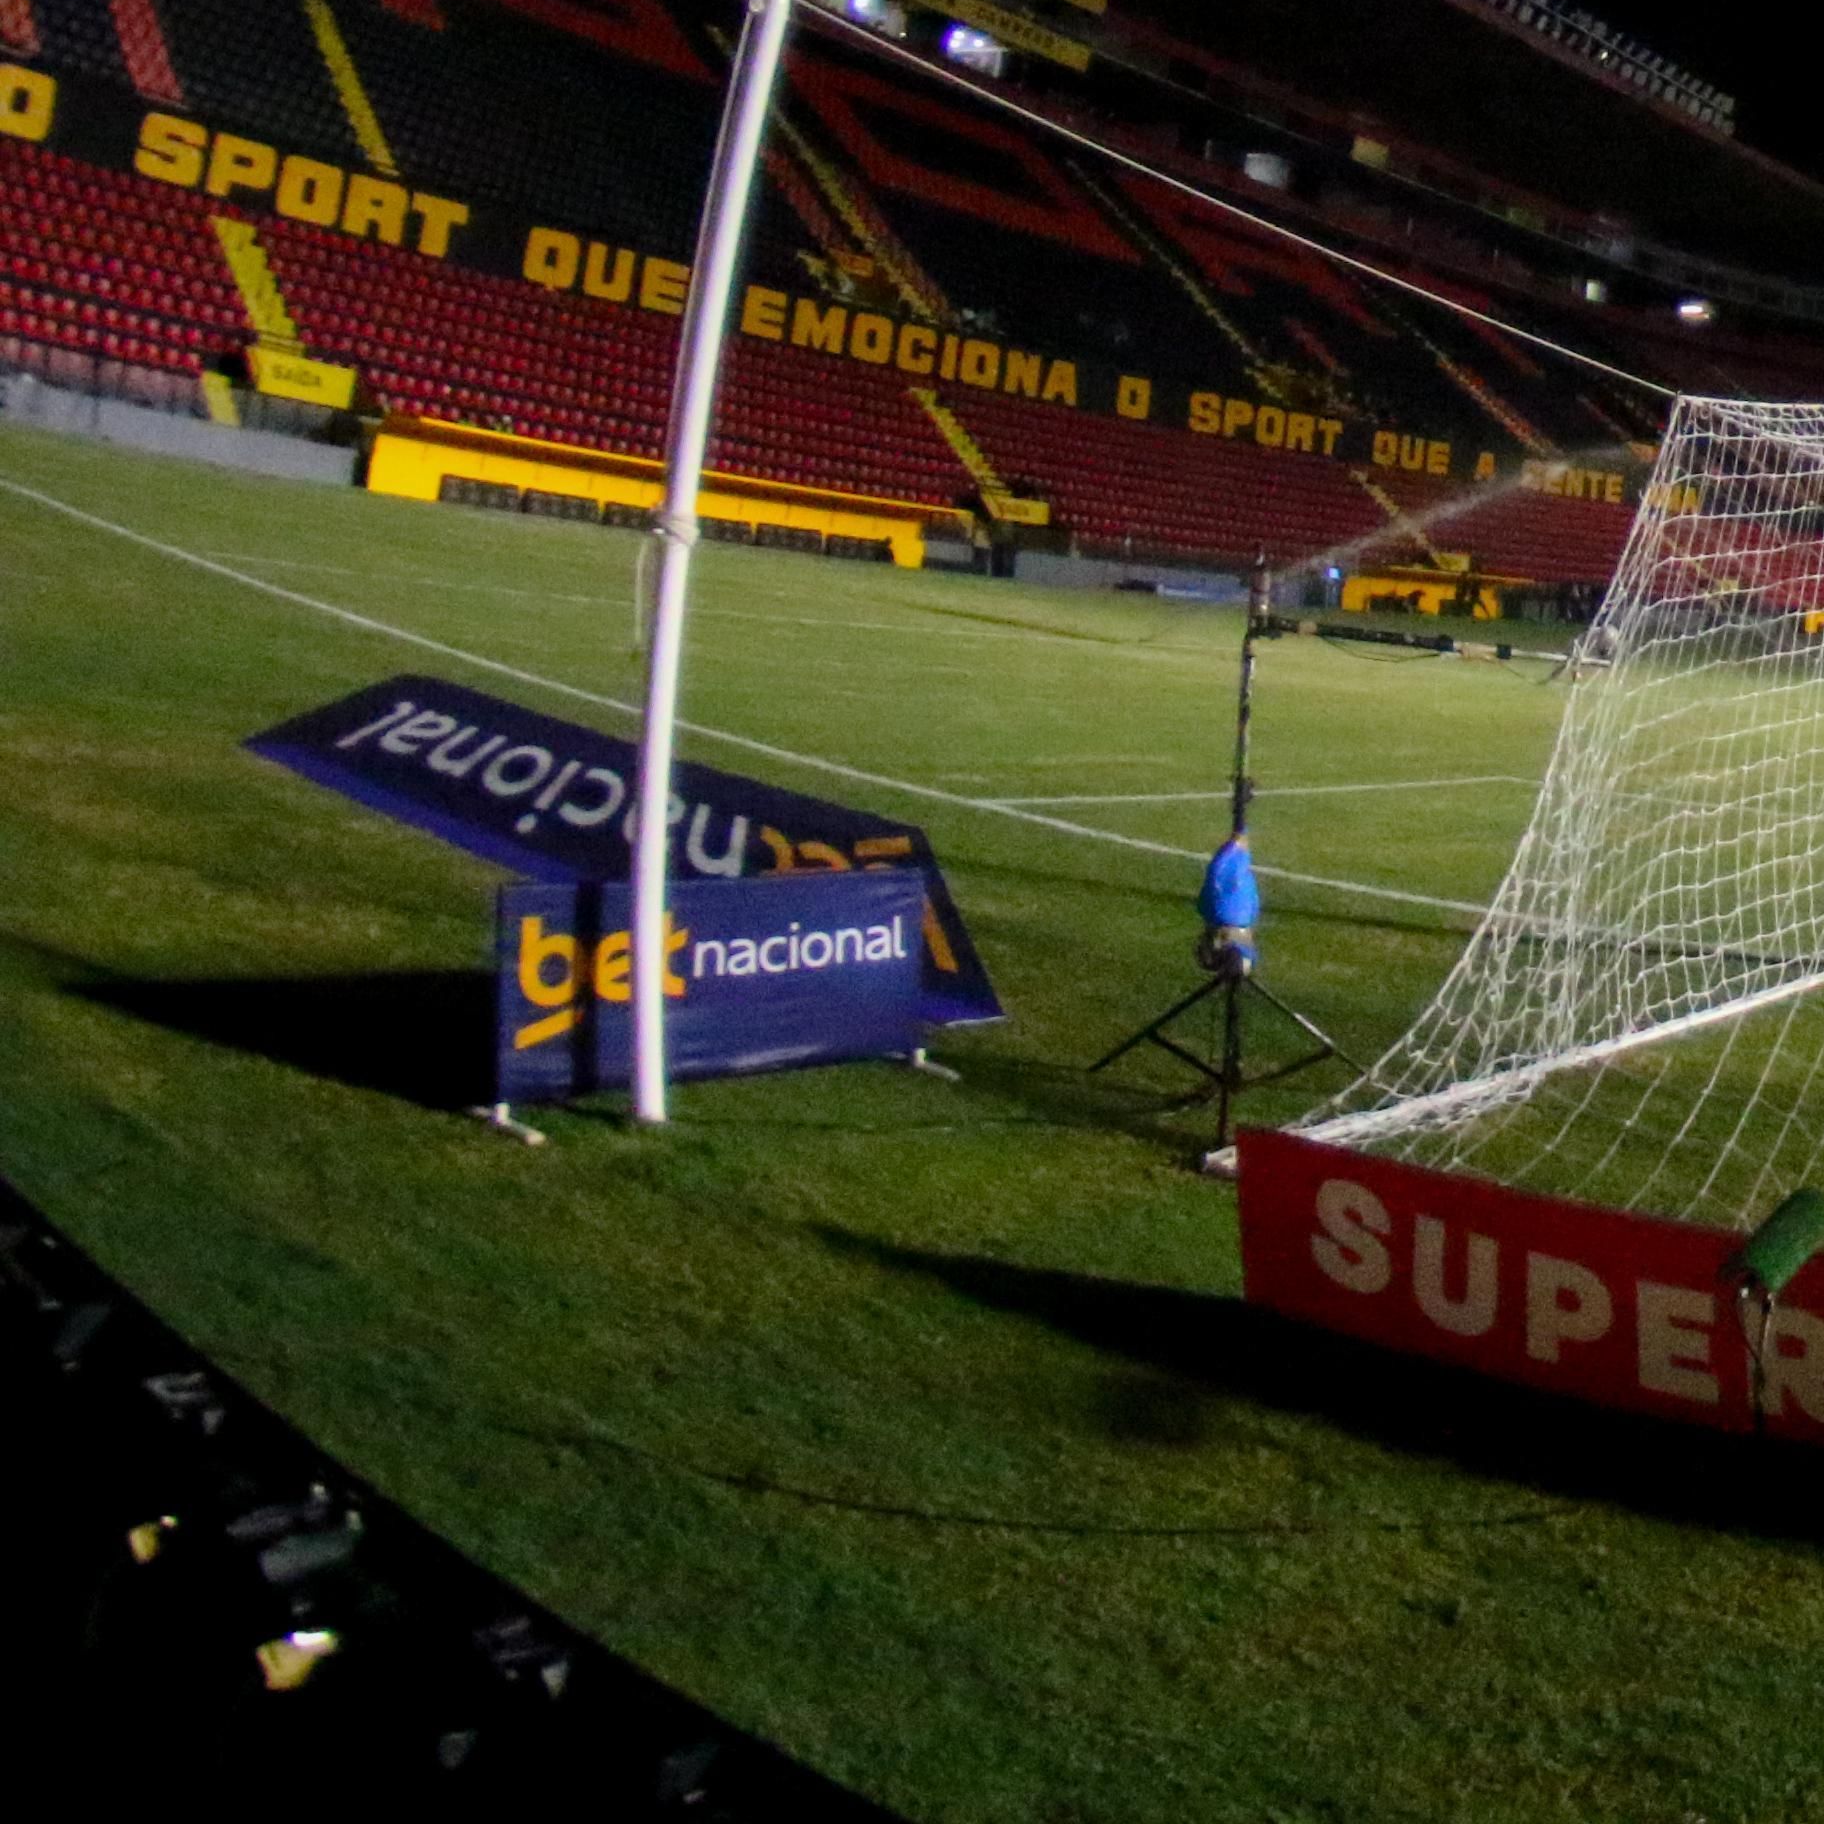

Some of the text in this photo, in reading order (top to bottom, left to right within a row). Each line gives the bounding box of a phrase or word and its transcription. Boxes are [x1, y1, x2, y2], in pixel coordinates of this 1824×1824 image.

[134, 112, 469, 257] SPORT
[523, 228, 694, 316] QUE
[742, 285, 1078, 408] EMOCIONA
[1117, 376, 1151, 420] O
[1189, 390, 1344, 459] SPORT
[1371, 428, 1450, 475] QUE
[1475, 450, 1496, 480] A
[692, 915, 907, 978] nacional
